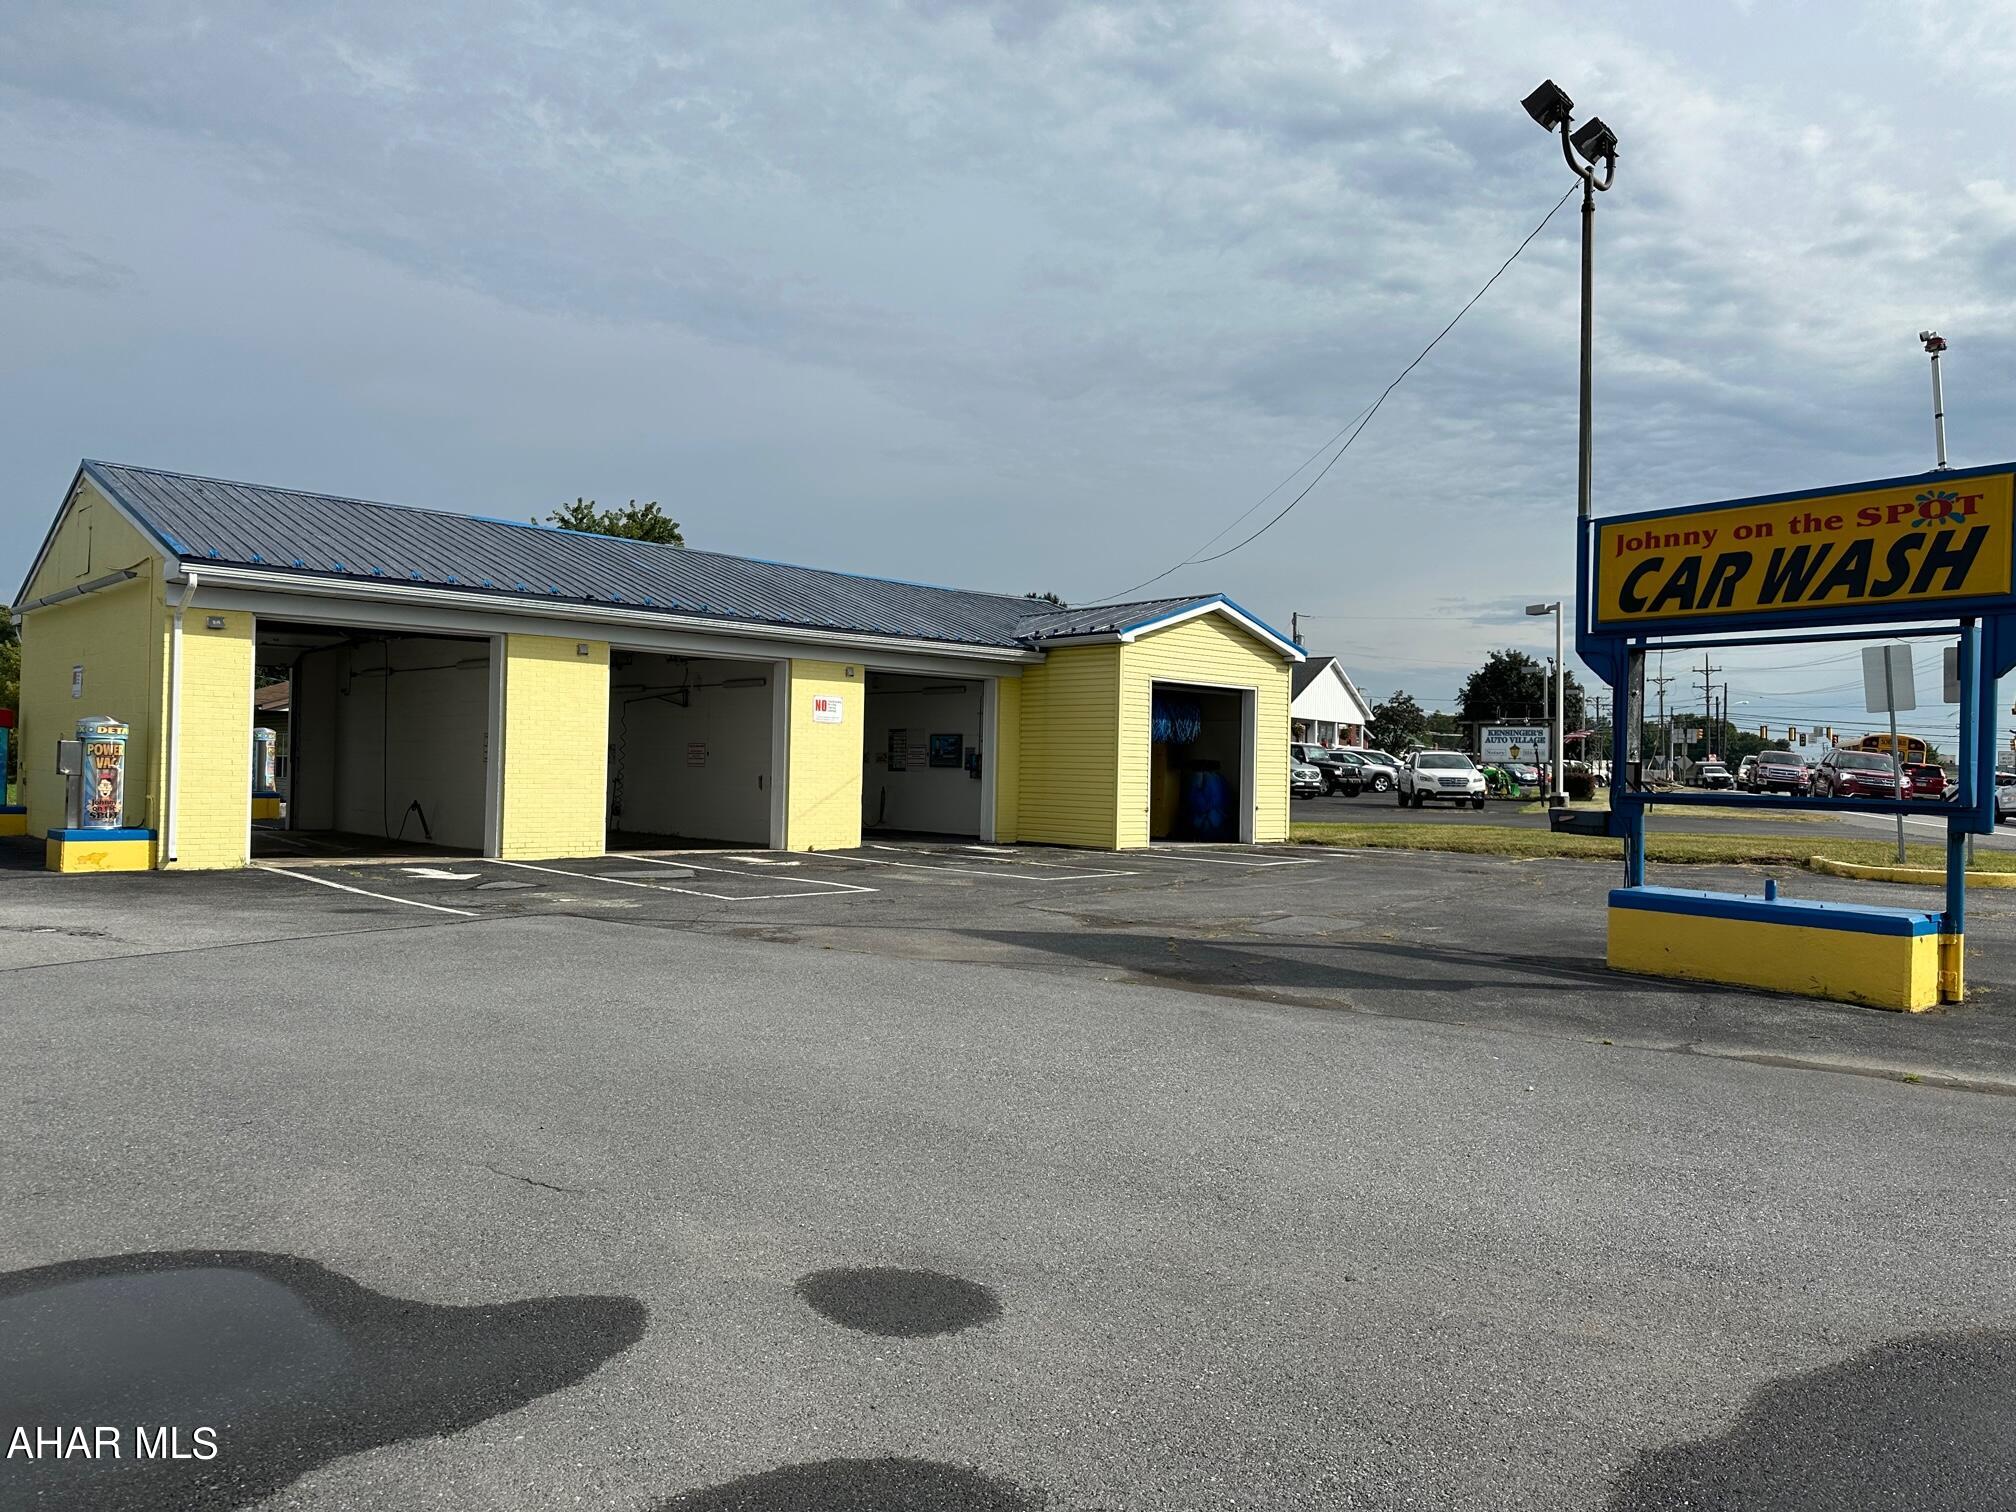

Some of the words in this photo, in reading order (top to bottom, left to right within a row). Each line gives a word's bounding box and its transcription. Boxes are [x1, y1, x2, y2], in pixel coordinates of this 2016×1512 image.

[1616, 528, 1718, 558] Johnny
[1733, 522, 1773, 541] on
[1789, 512, 1844, 534] the
[1857, 493, 1984, 528] SPOT
[1618, 550, 1753, 614] CAR
[1757, 525, 1991, 605] WASH
[815, 699, 827, 712] NO
[1487, 729, 1544, 737] KENSINGER'S
[1485, 736, 1508, 744] AUTO
[1509, 736, 1546, 744] VILLAGE
[87, 743, 124, 756] POWER
[96, 757, 117, 769] VAC
